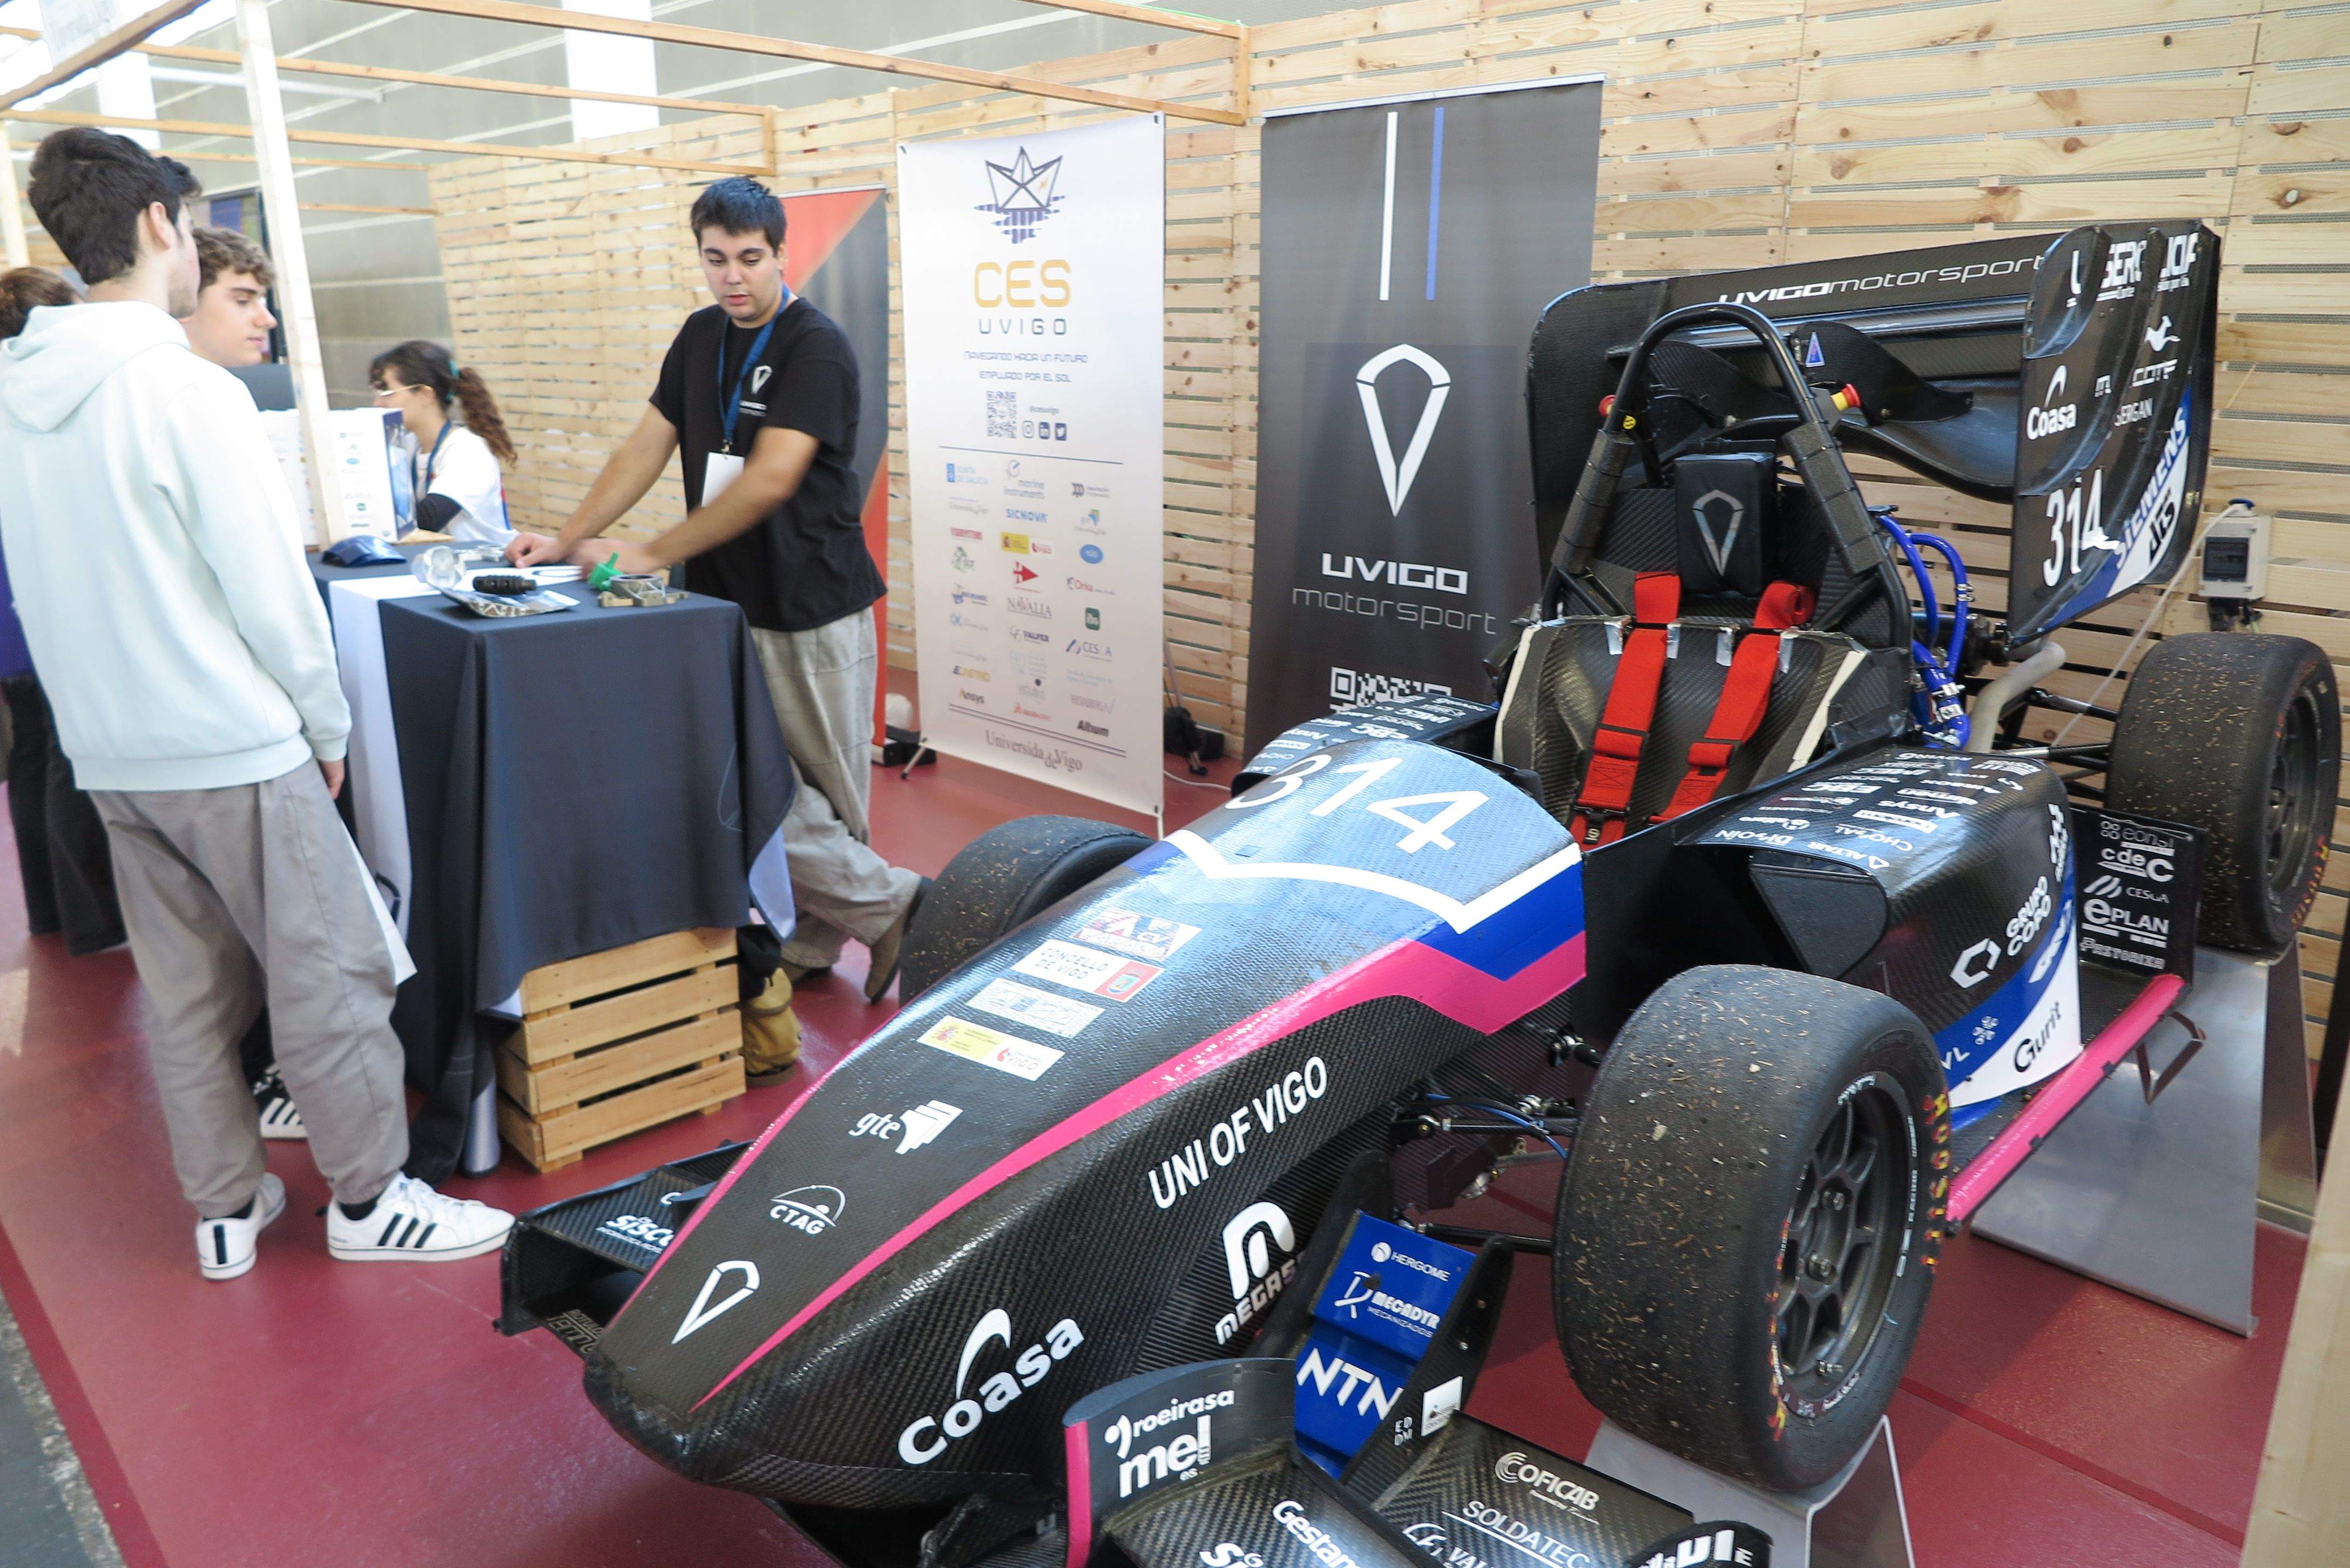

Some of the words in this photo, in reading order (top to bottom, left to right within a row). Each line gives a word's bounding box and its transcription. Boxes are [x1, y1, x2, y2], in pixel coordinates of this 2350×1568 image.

[974, 259, 1071, 308] CES
[978, 317, 1067, 335] UVIGO
[2027, 403, 2077, 441] Coasa
[2043, 468, 2121, 587] 314
[1321, 552, 1468, 595] UVIGO
[1292, 587, 1496, 636] motorsport
[1225, 754, 1490, 854] 314
[1876, 800, 1961, 819] Ansys
[1806, 841, 1867, 860] ALTAIR
[1939, 1047, 1971, 1070] VL
[2014, 1001, 2062, 1072] Gurit
[848, 1113, 901, 1140] gte
[1148, 1138, 1210, 1209] UNI
[1209, 1105, 1252, 1167] OF
[1252, 1056, 1328, 1134] VIGO
[769, 1204, 826, 1235] CTAG
[897, 1317, 1085, 1465] Coasa
[1296, 1347, 1404, 1421] NTN
[1495, 1451, 1600, 1510] COFICAB
[1462, 1501, 1591, 1568] SOLDATEC
